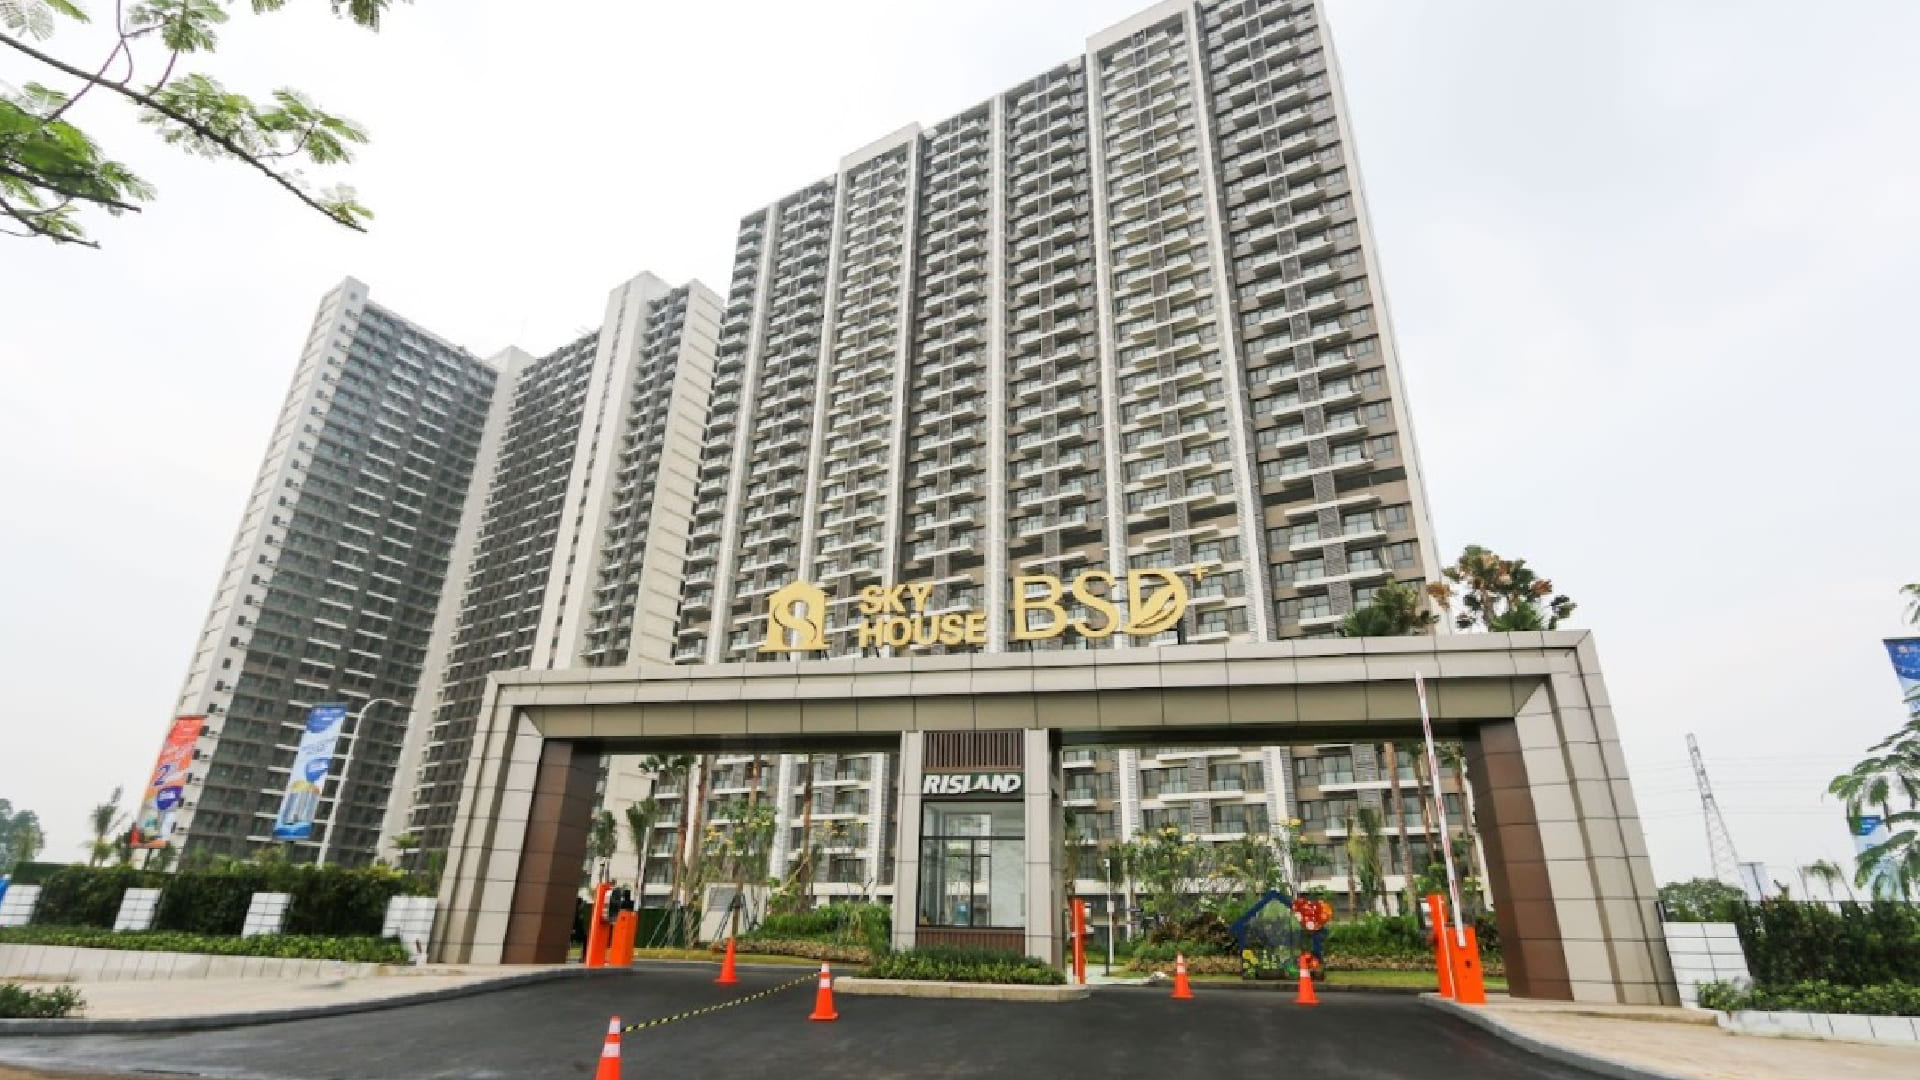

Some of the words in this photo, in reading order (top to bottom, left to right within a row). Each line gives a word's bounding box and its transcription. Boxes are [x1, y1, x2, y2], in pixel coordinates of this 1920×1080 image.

[859, 583, 932, 613] SKY
[859, 613, 987, 648] HOUSE
[922, 774, 1021, 794] RISLAND
